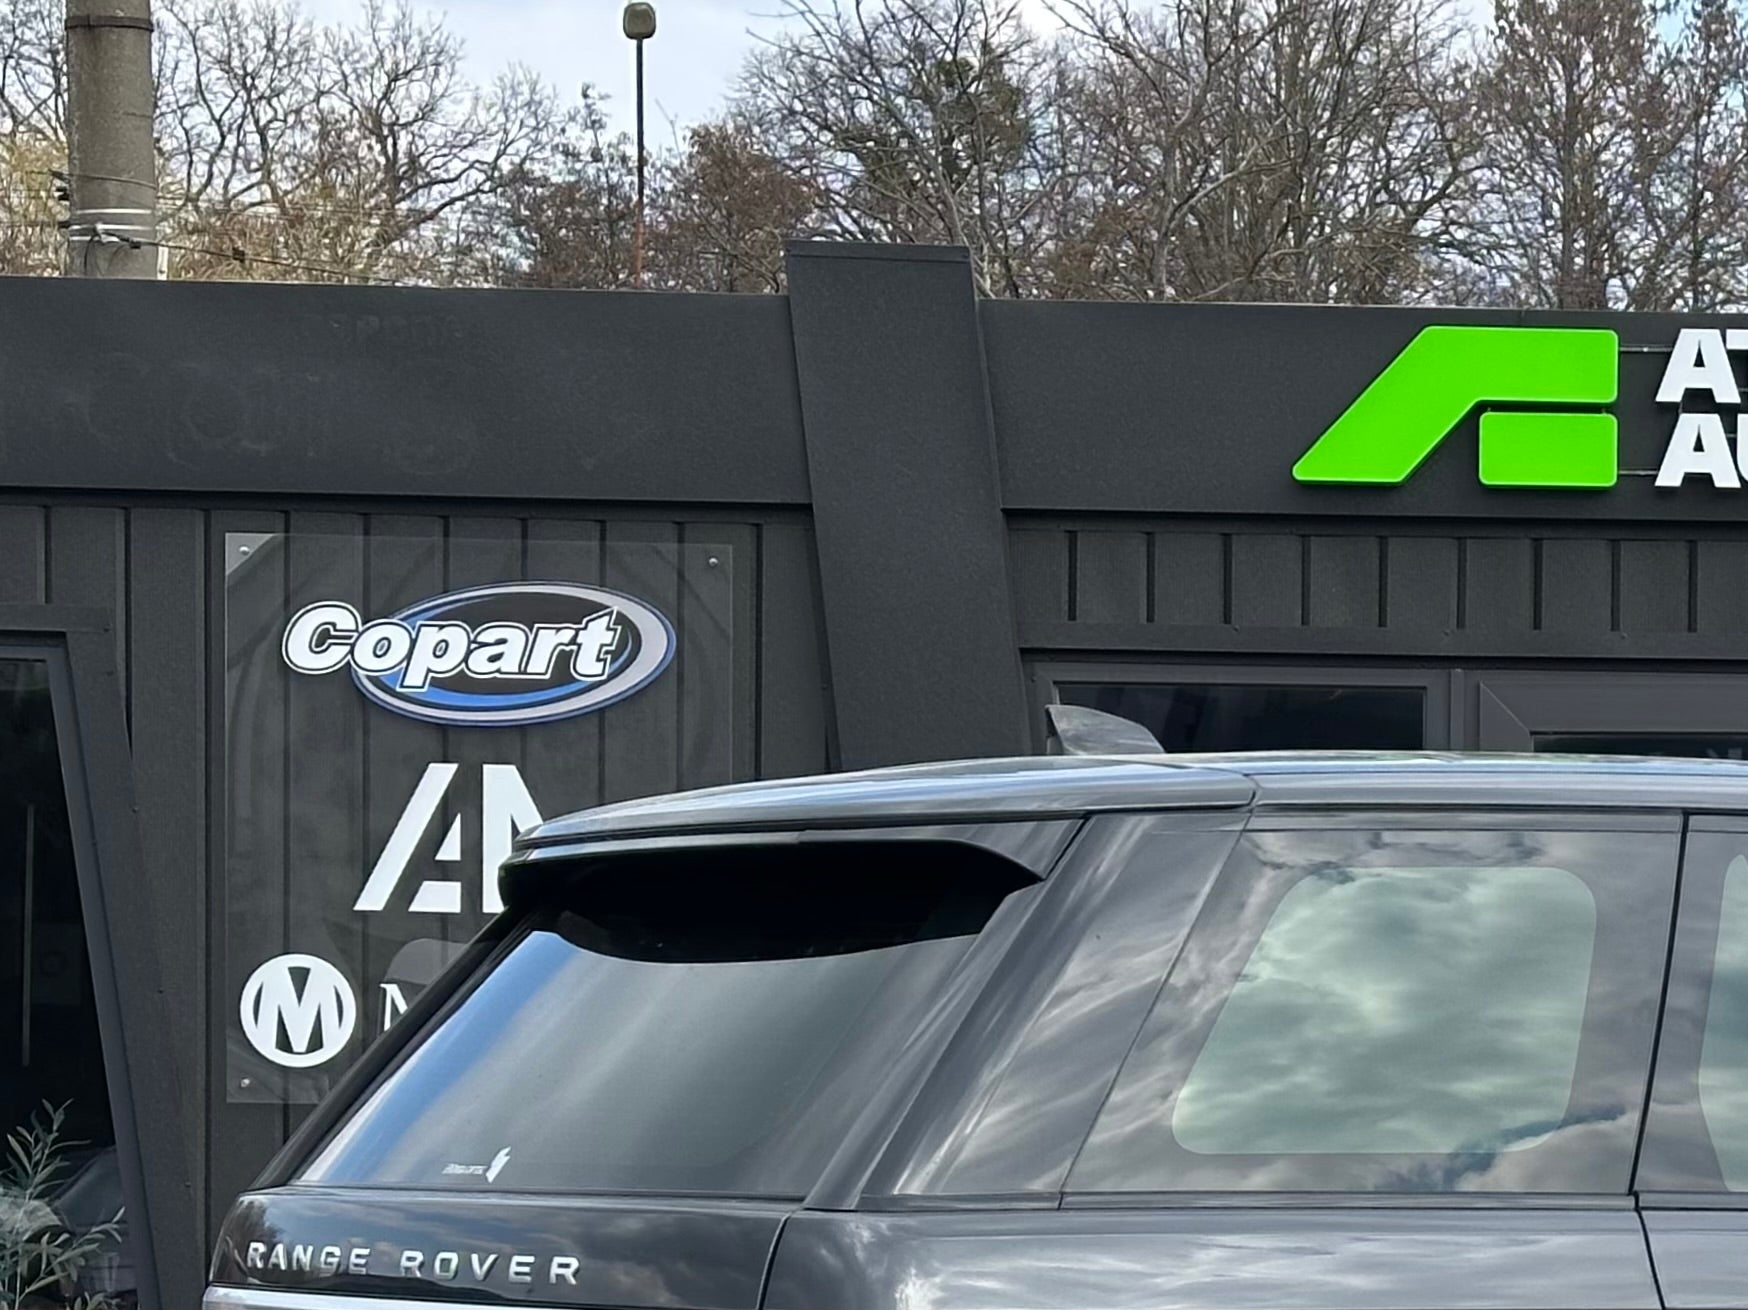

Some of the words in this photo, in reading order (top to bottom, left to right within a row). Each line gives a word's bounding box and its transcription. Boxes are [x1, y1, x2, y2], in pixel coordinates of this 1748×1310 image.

[282, 601, 620, 692] Copart
[247, 1241, 370, 1276] RANGE
[400, 1250, 581, 1285] ROVER
